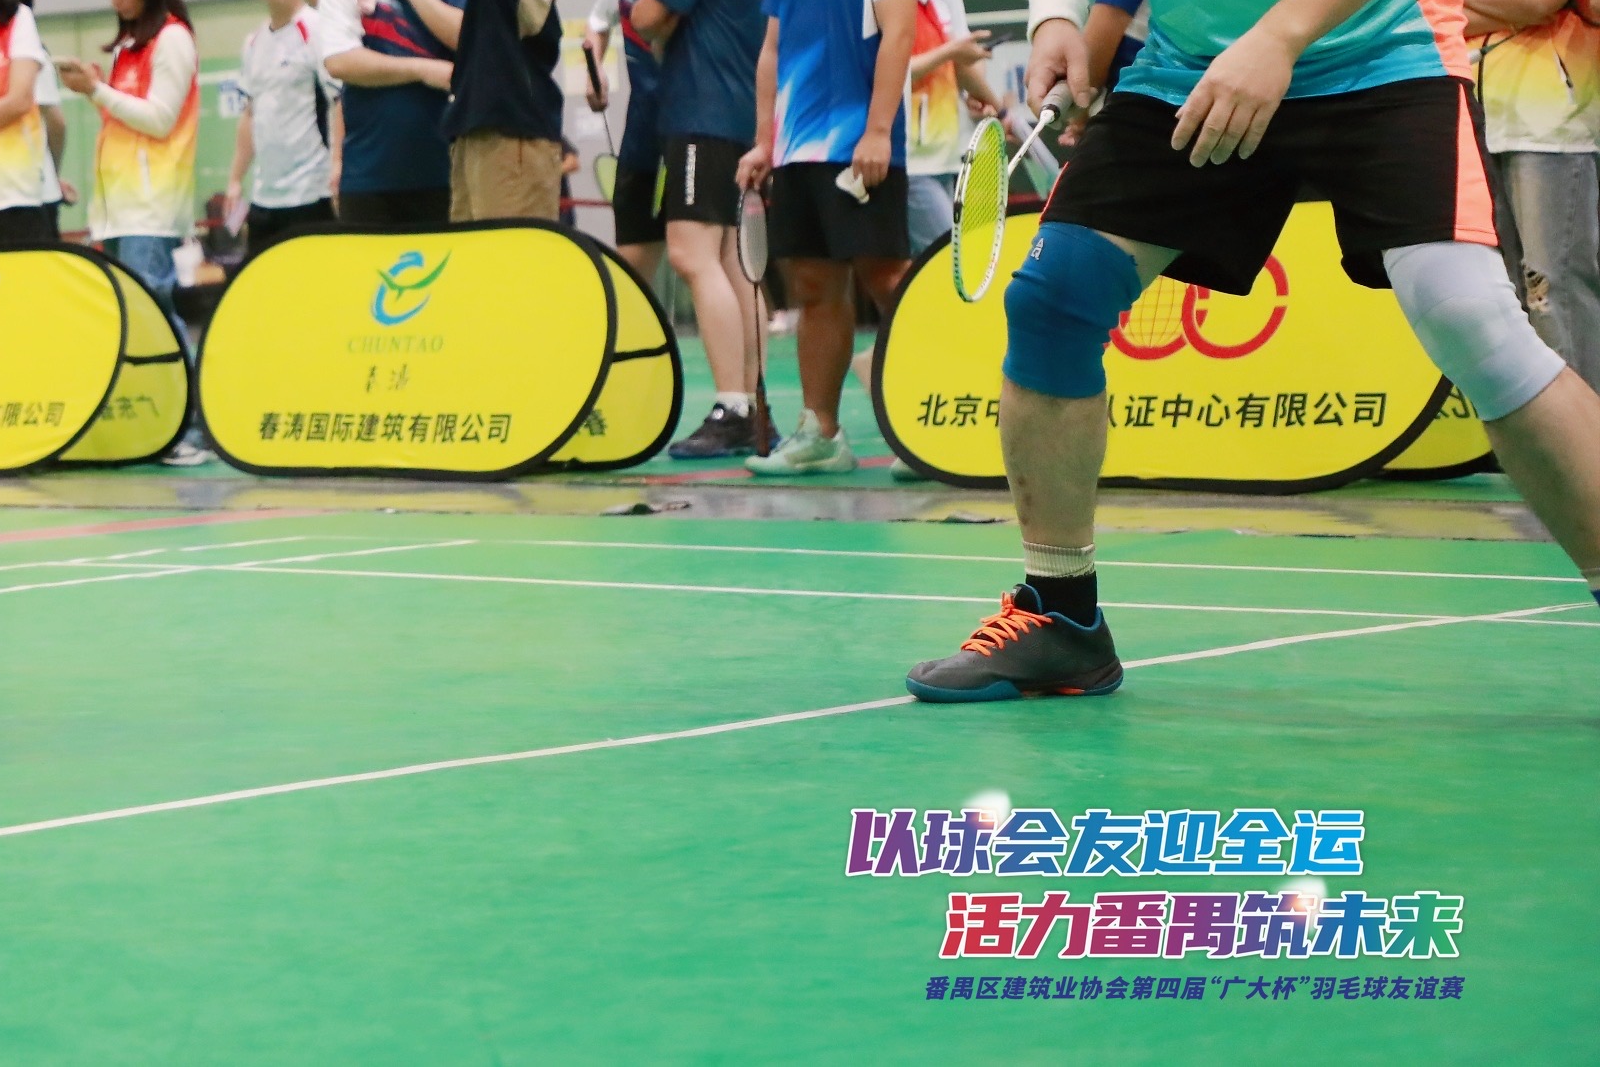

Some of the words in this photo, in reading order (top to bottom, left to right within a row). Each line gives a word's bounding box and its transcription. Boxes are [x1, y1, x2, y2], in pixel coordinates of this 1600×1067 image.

[347, 336, 445, 354] CHUNTAO
[258, 410, 513, 444] 春涛国际建筑有限公司
